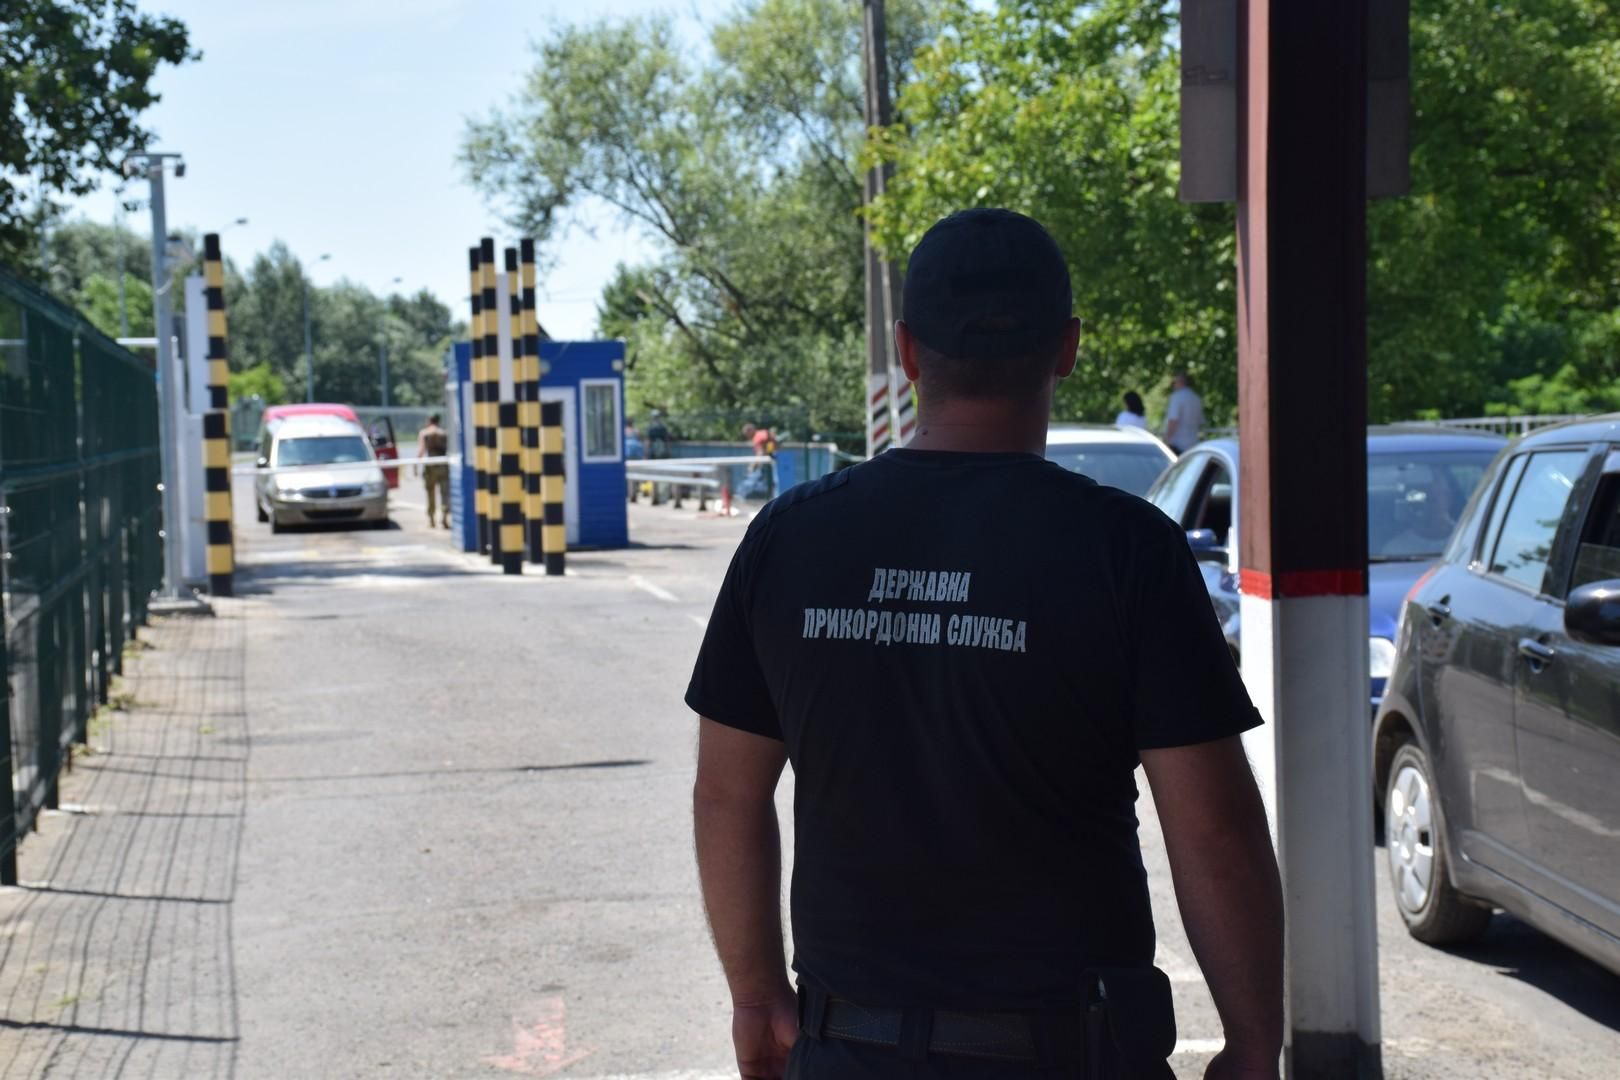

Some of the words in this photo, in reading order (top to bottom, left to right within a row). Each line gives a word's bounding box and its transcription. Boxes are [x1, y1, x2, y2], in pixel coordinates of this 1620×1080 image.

[868, 568, 971, 603] ДЕРЖАВНА
[803, 608, 941, 646] ПРИКОРДОННА
[947, 614, 1027, 653] СЛУЖБА
